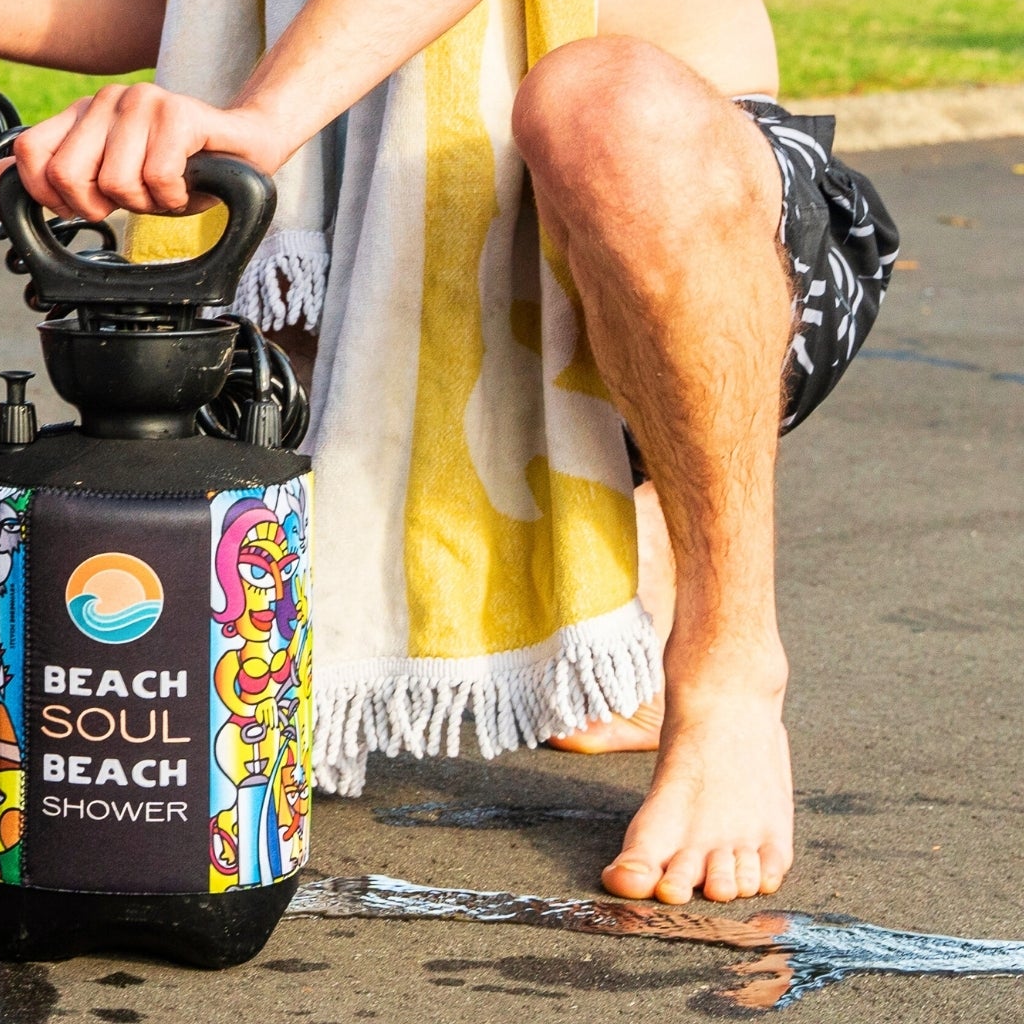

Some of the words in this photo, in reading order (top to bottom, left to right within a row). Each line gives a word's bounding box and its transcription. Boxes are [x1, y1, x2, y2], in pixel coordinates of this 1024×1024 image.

[45, 666, 187, 699] BEACH
[41, 704, 191, 743] SOUL
[43, 753, 187, 787] BEACH
[42, 796, 188, 822] SHOWER
